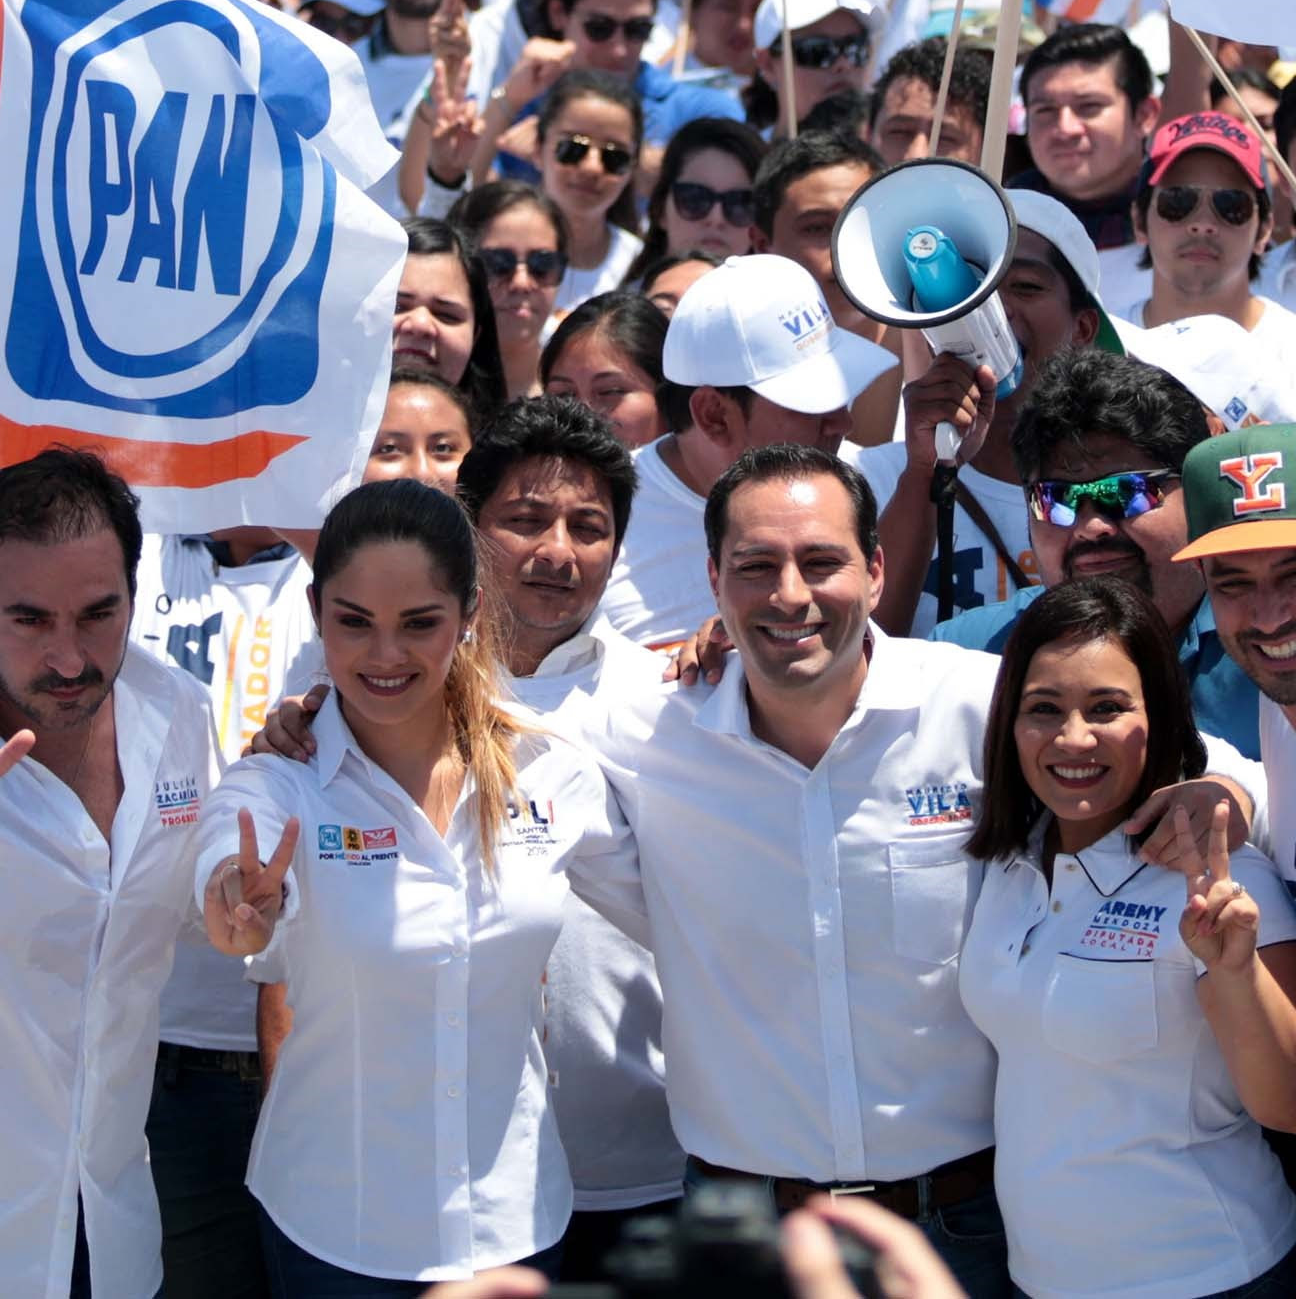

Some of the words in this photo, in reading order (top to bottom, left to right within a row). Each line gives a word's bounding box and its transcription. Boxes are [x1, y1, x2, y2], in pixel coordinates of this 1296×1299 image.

[79, 79, 260, 298] PAN
[1219, 451, 1287, 519] Y
[907, 791, 971, 814] VILA
[1097, 900, 1168, 923] AREMY
[1093, 914, 1160, 934] MENDOZA
[1085, 928, 1154, 949] DIPUTADA
